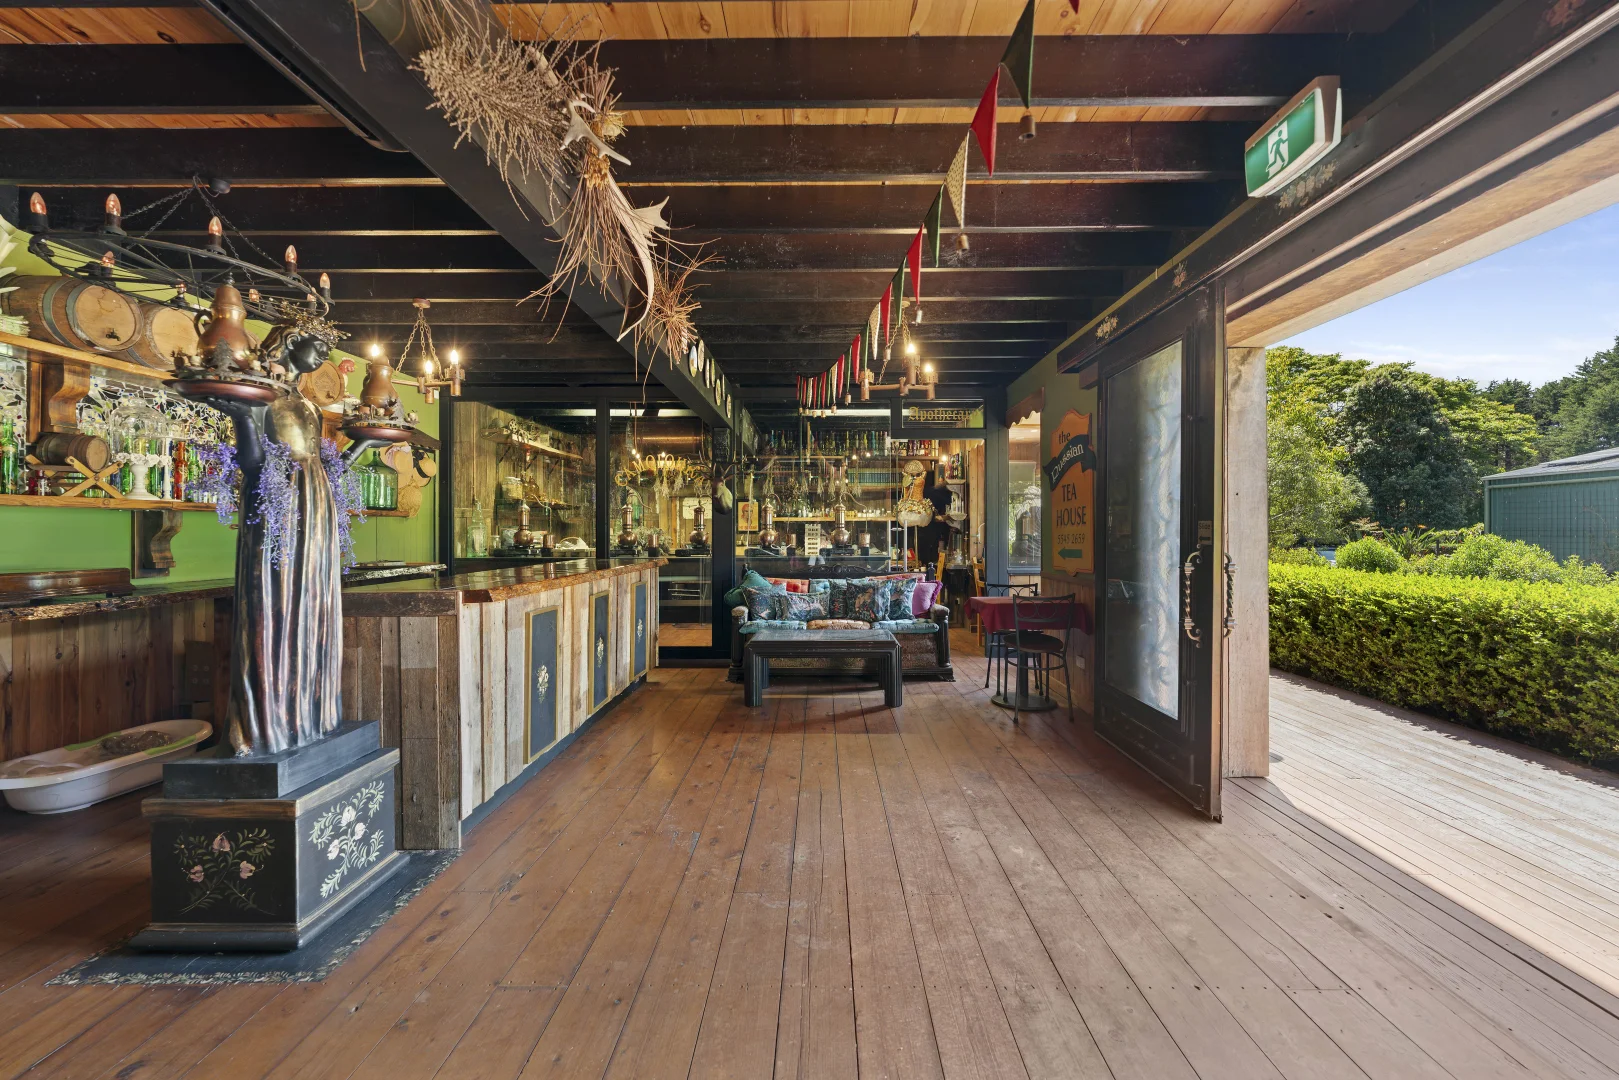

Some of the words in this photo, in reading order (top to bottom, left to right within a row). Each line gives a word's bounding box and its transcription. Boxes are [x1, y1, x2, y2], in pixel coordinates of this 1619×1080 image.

[908, 406, 979, 422] Apothecar
[1058, 431, 1071, 445] the
[1051, 444, 1084, 484] Russian
[1062, 483, 1077, 502] TEA
[1056, 506, 1087, 528] HOUSE
